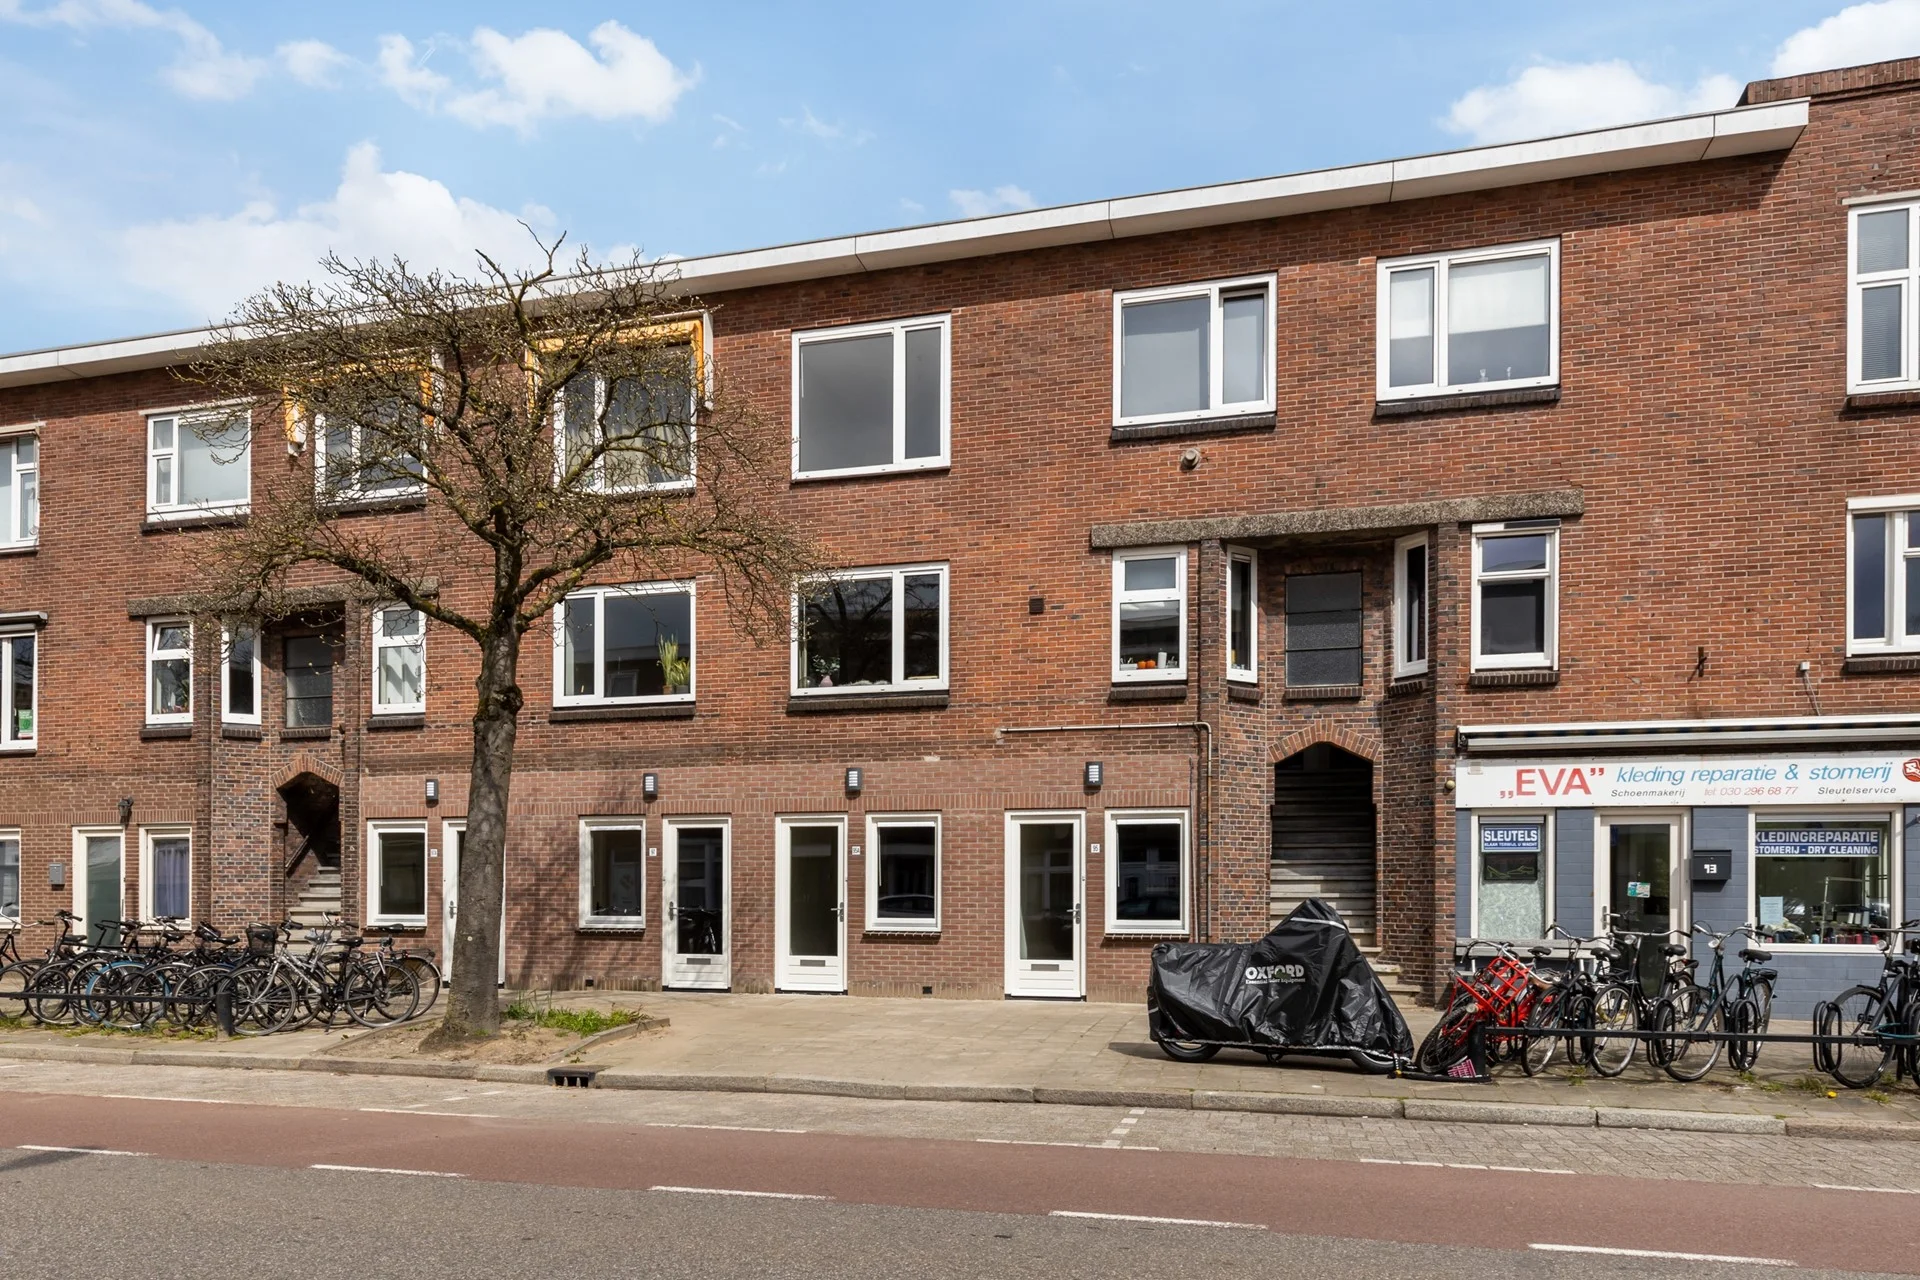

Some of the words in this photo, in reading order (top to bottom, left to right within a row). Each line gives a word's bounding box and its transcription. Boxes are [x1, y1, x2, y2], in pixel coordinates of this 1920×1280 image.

[1616, 766, 1685, 786] kleding
[1690, 765, 1776, 784] reparatie
[1784, 763, 1799, 780] &
[1809, 762, 1893, 782] stomerij
[1611, 789, 1686, 798] Schoenmakerij
[1719, 787, 1741, 796] 030
[1744, 787, 1765, 796] 296
[1767, 786, 1781, 795] 68
[1785, 786, 1798, 795] 77
[1818, 786, 1897, 795] Sleutelservice
[1484, 830, 1538, 842] SLEUTELS
[1755, 831, 1878, 842] KLEDINGREPARATIE
[1755, 845, 1800, 855] STOMERIJ
[1808, 845, 1827, 854] DRY
[1829, 845, 1878, 854] CLEANING
[1245, 965, 1304, 979] OXFORD
